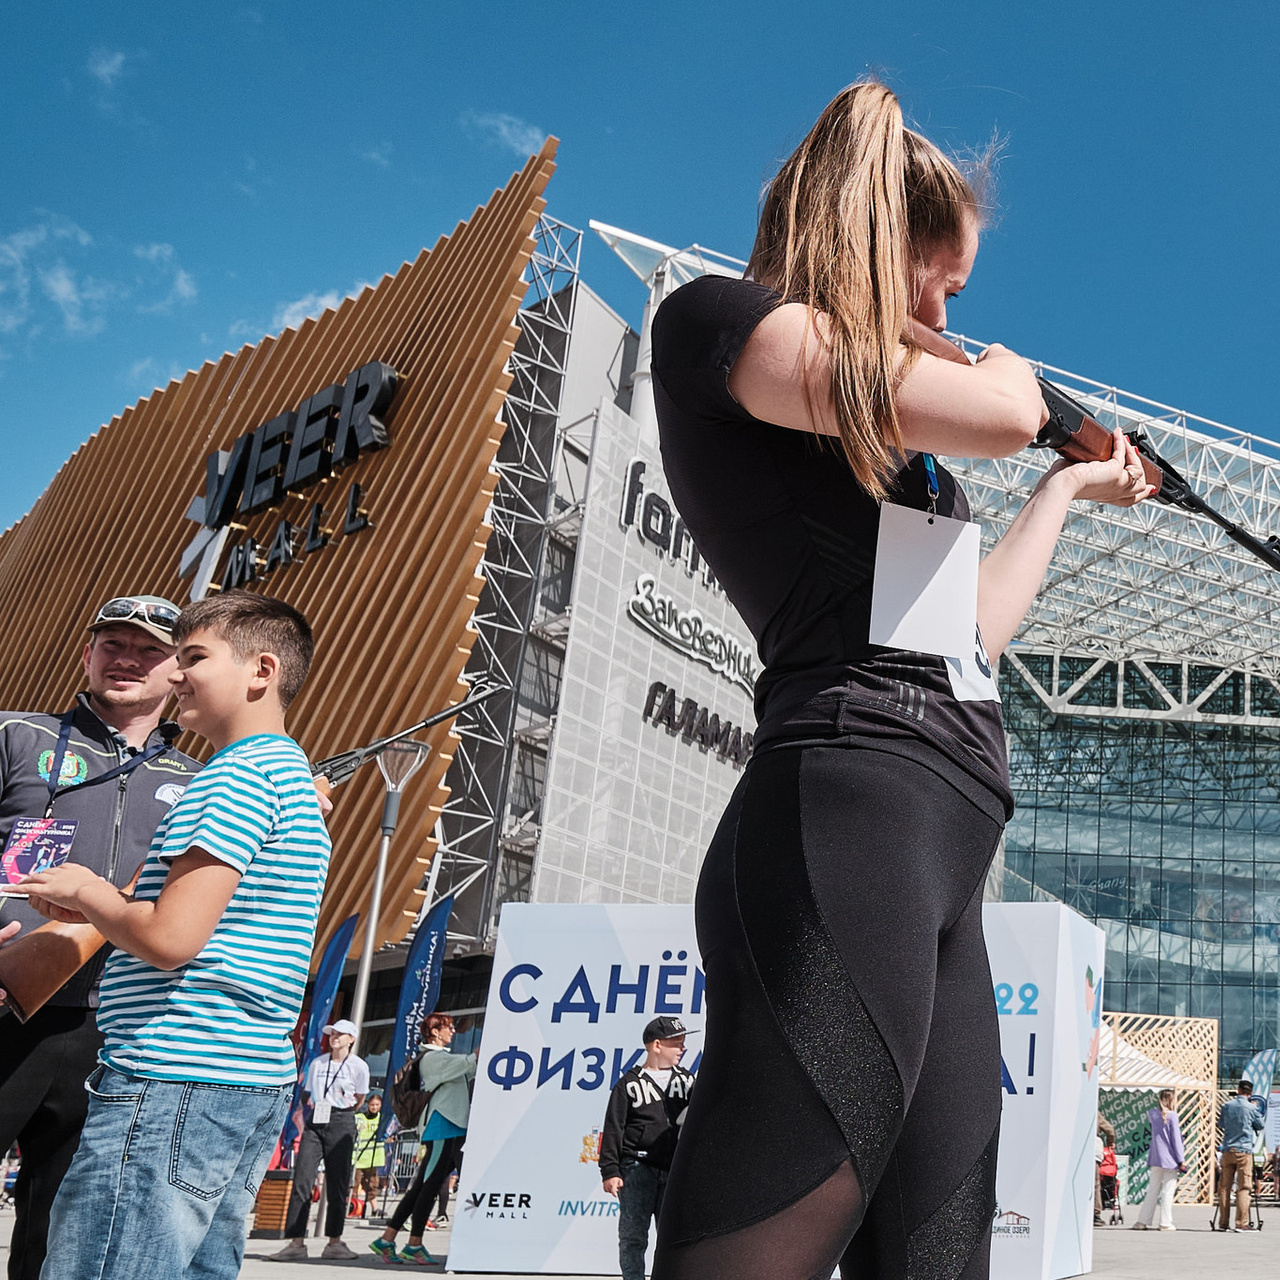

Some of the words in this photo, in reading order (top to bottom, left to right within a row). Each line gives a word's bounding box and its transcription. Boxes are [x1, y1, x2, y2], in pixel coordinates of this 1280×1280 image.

[205, 360, 396, 528] VEER
[219, 483, 370, 593] MALL
[499, 963, 543, 1013] С
[994, 982, 1040, 1016] 22
[471, 1192, 532, 1209] VEER
[486, 1211, 528, 1220] MALL
[558, 1200, 621, 1218] INVITR
